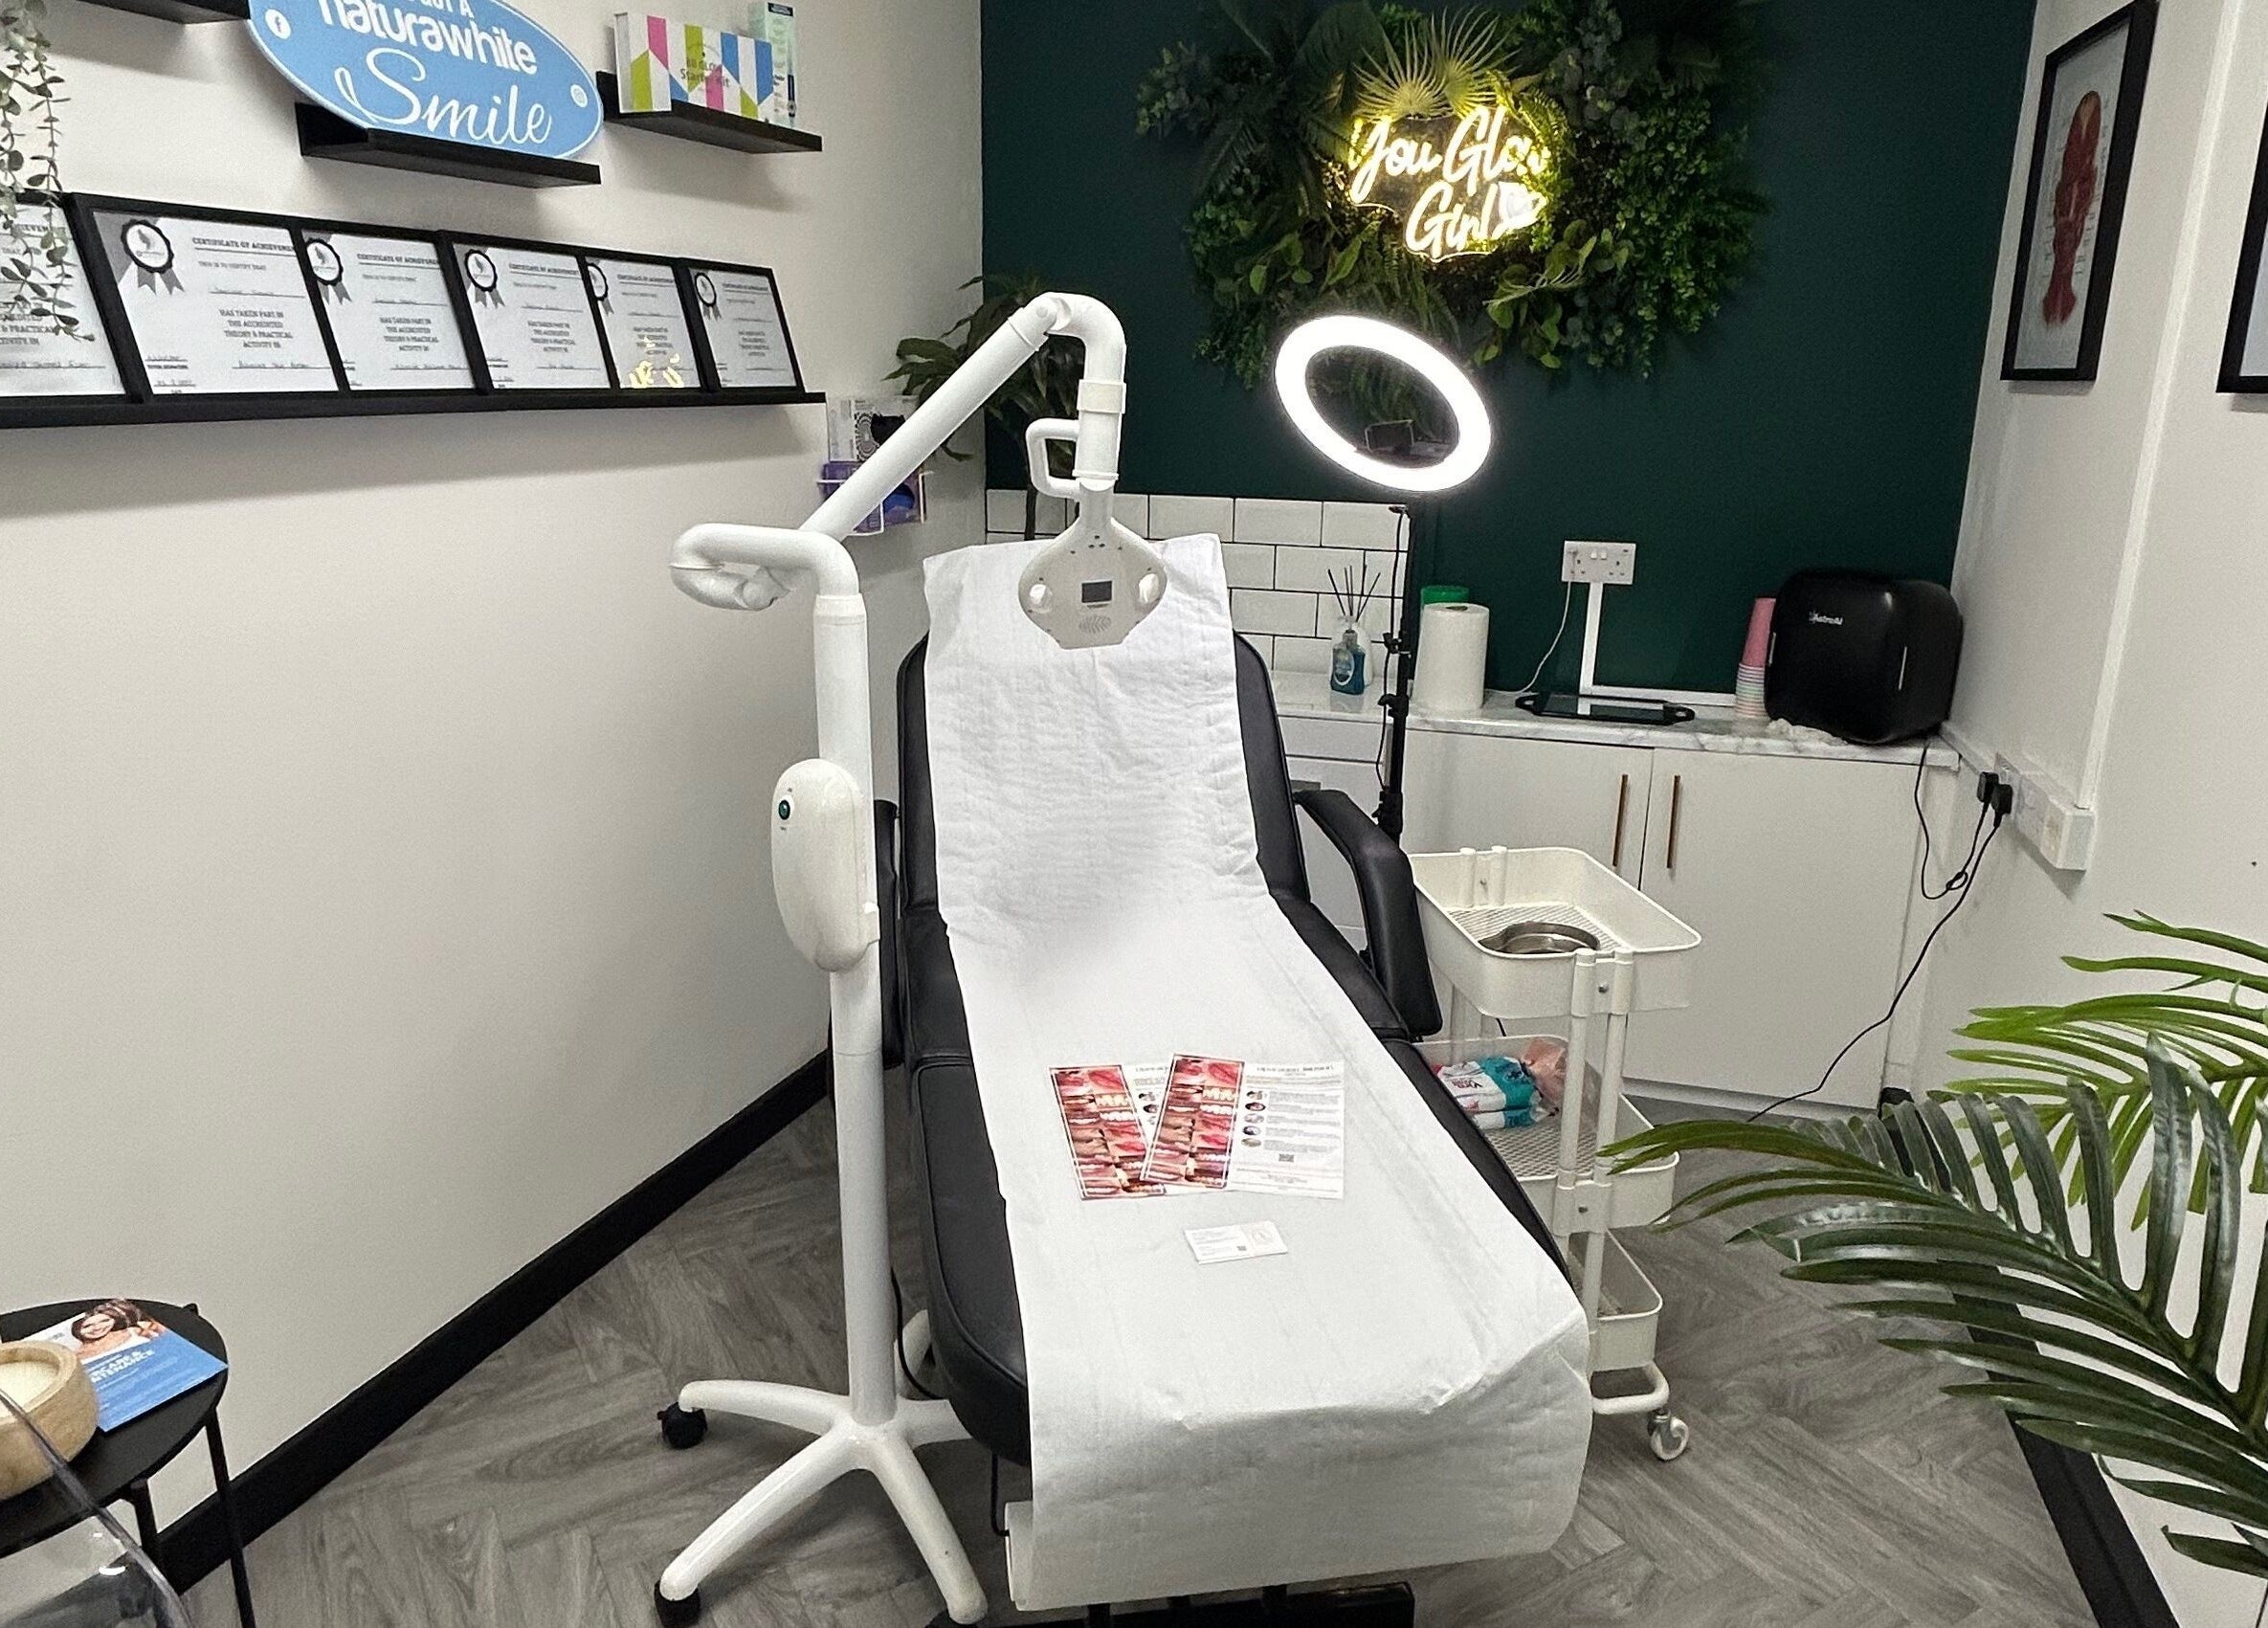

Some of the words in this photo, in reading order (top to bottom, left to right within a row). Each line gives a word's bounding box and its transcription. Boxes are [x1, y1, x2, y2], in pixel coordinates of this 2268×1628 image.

[319, 0, 538, 75] naturawhite
[334, 47, 552, 145] Smile
[1348, 116, 1443, 204] You
[1405, 180, 1500, 260] Girl
